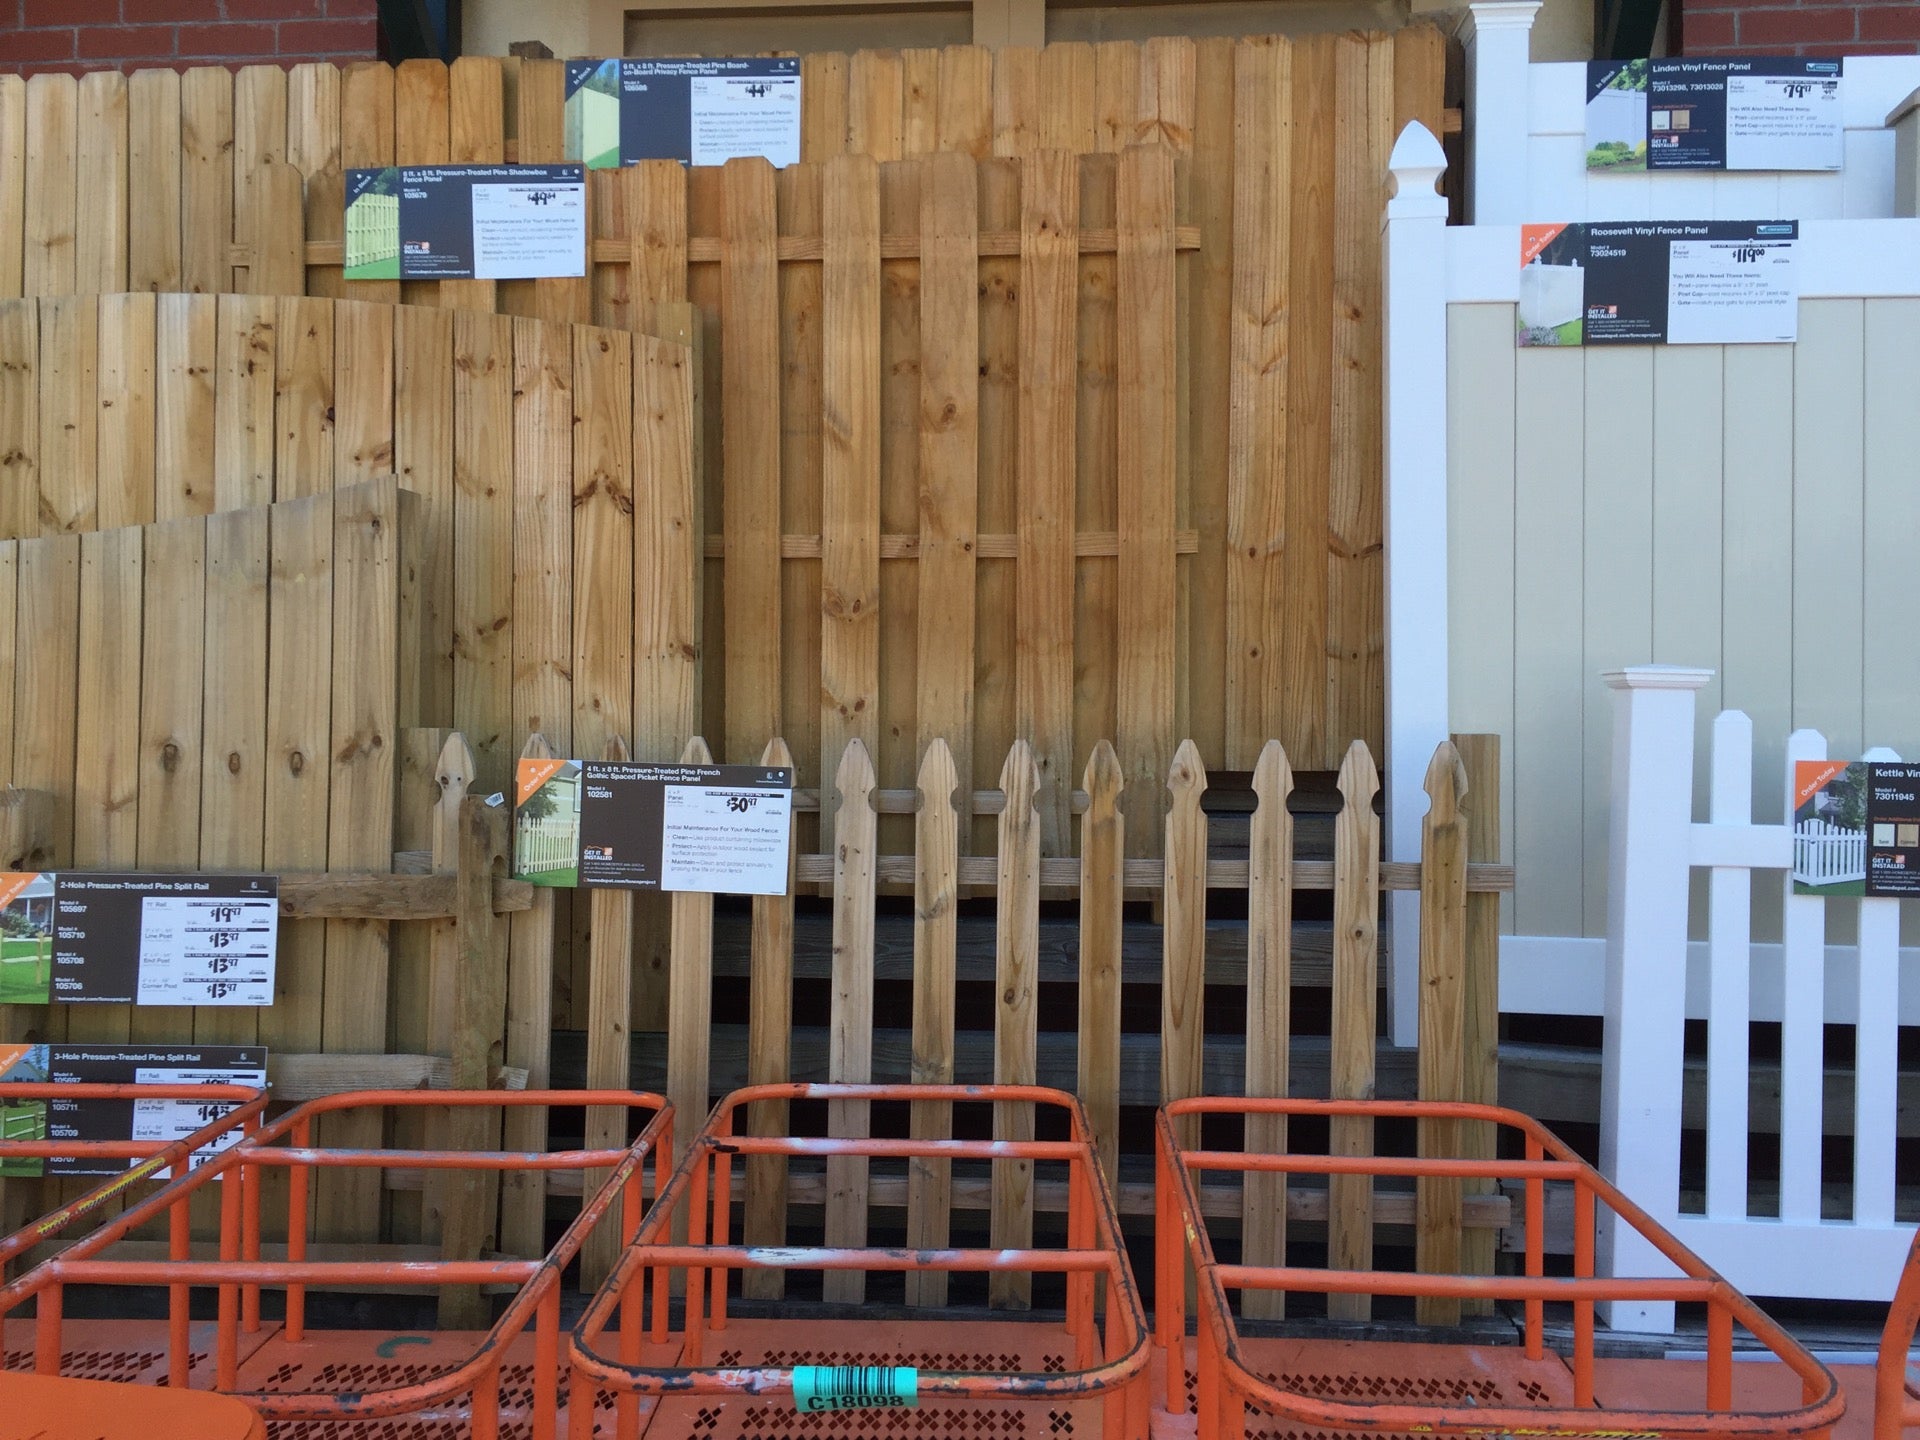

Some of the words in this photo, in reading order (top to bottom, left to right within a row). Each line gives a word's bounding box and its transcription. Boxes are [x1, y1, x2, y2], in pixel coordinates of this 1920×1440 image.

[656, 62, 711, 70] Pressure-Treated
[1682, 64, 1700, 72] Vinyl
[1591, 228, 1632, 236] Roosevelt
[1635, 228, 1655, 236] Vinyl
[1526, 242, 1540, 257] Order
[1540, 229, 1555, 243] Today
[1876, 769, 1904, 777] Kettle
[523, 777, 540, 792] Order
[539, 763, 554, 778] Today
[1801, 780, 1818, 796] Order
[1817, 766, 1836, 782] Today
[174, 883, 192, 891] Split
[808, 1395, 904, 1410] C18098
